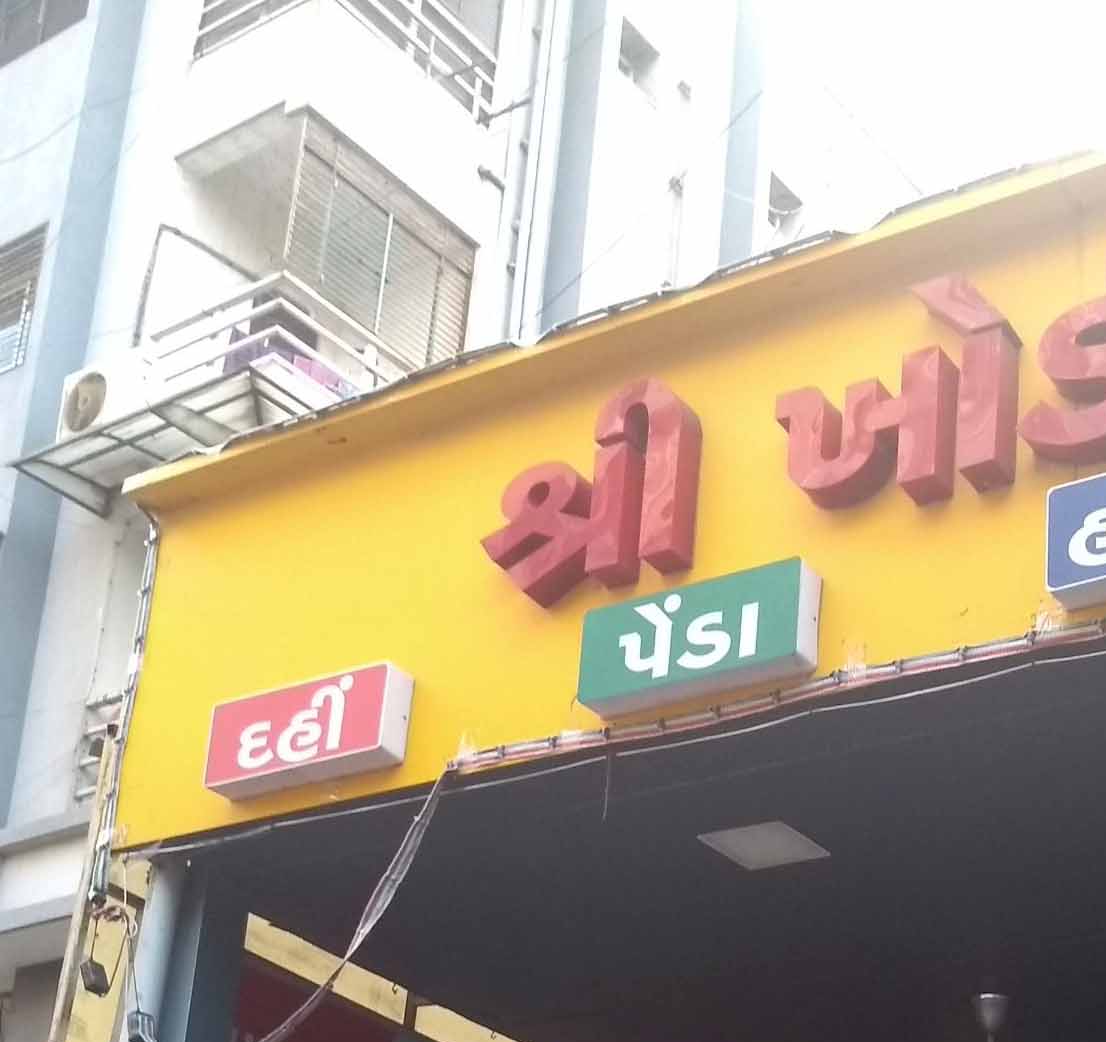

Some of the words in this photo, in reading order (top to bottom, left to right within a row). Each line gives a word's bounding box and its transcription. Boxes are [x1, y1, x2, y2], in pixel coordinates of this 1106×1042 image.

[480, 376, 703, 608] શ્રી
[618, 593, 760, 679] પેંડા
[237, 674, 354, 769] દહીં
